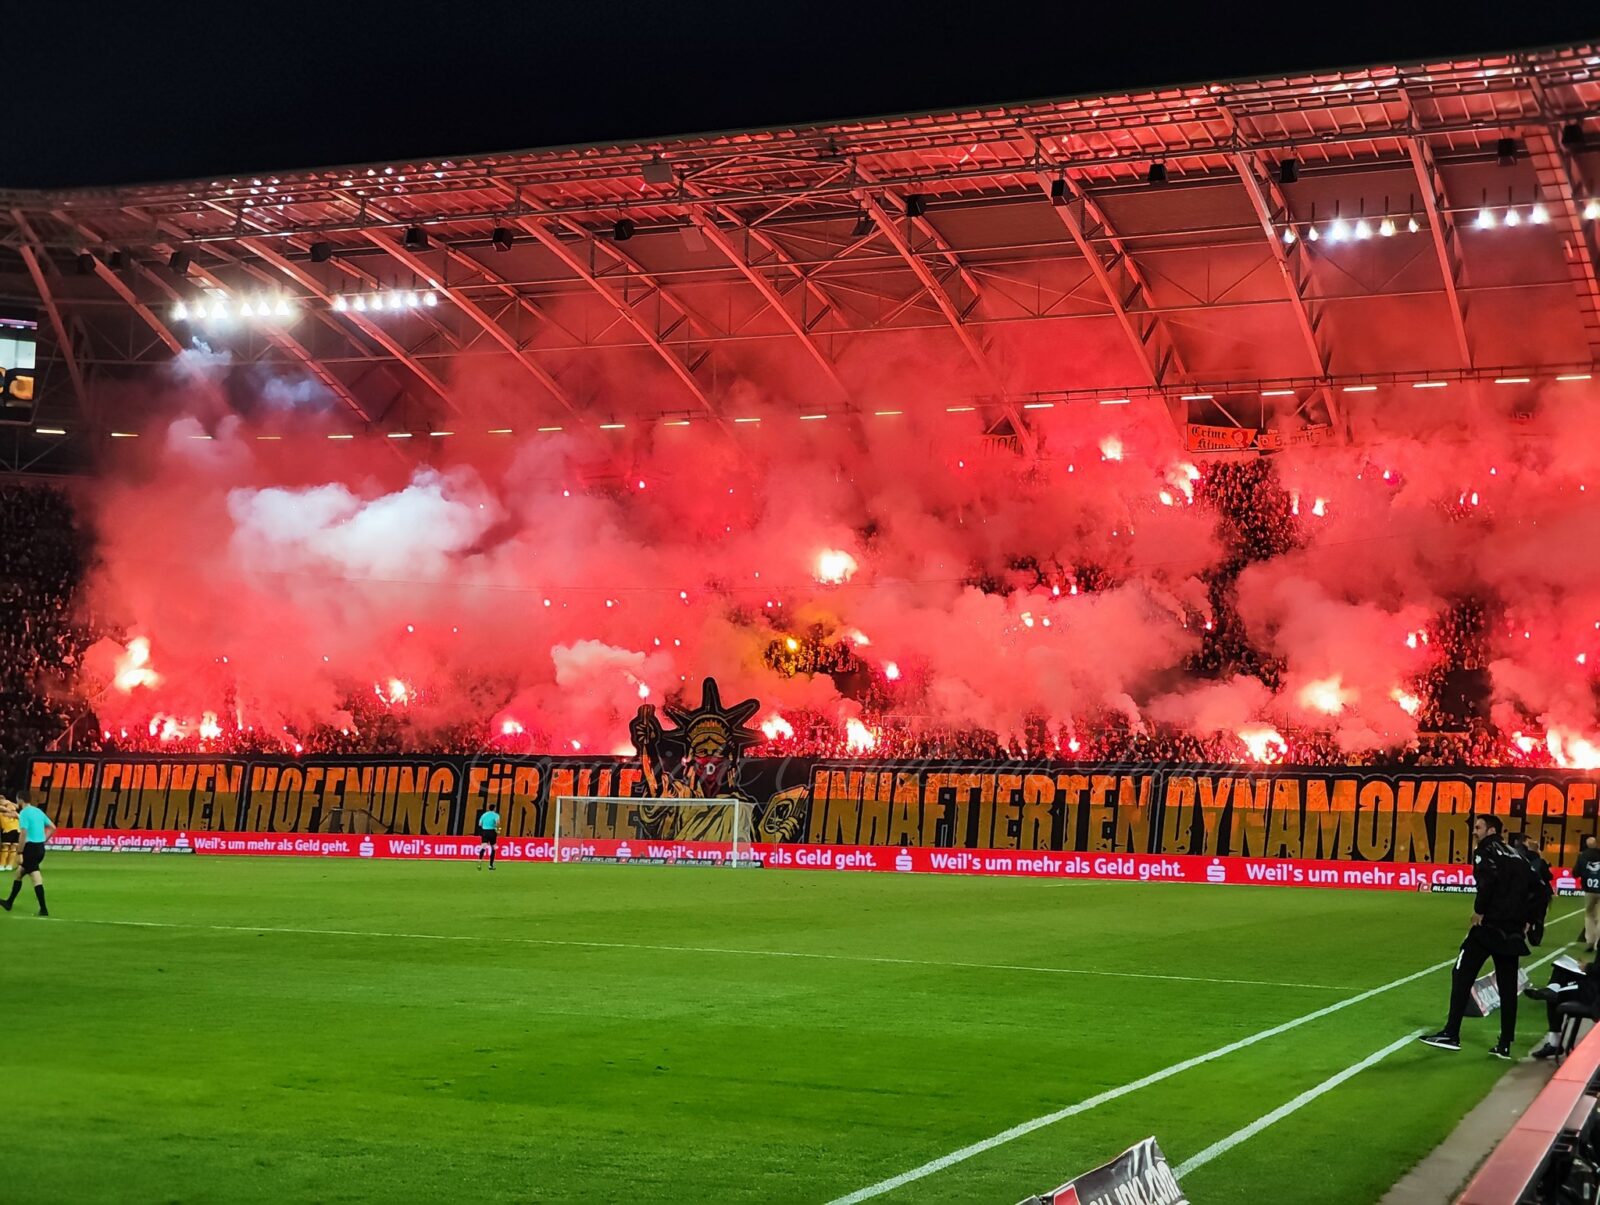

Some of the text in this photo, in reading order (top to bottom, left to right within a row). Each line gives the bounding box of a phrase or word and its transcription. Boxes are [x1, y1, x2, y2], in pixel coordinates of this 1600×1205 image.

[94, 764, 243, 832] FUNKEN
[246, 766, 454, 835] HOFFNUNG
[544, 769, 642, 839] ALLE
[808, 770, 1152, 854] INHAFTIERTEN
[1162, 777, 1600, 866] DYNAMOKREGE
[55, 837, 71, 845] um
[73, 835, 99, 845] mehr
[102, 836, 115, 846] als
[118, 835, 141, 847] Geld
[194, 838, 226, 849] Weil's
[228, 841, 245, 850] um
[247, 839, 275, 851] mehr
[277, 839, 293, 851] als
[295, 839, 319, 852] Geld
[322, 840, 350, 854] geht.
[389, 840, 431, 855] Weil's
[435, 844, 457, 855] um
[461, 842, 498, 856] meh
[501, 842, 521, 857] als
[648, 845, 694, 859] Weil's
[698, 849, 722, 859] um
[769, 848, 791, 864] als
[795, 849, 831, 866] Geld
[835, 851, 877, 870] geht.
[930, 853, 1185, 880] Weil's um mehr als Geld geht.
[1246, 863, 1303, 882] Weil's
[1308, 868, 1338, 883] um
[1344, 866, 1394, 885] mehr
[1399, 867, 1426, 886] als
[1587, 878, 1599, 888] 02
